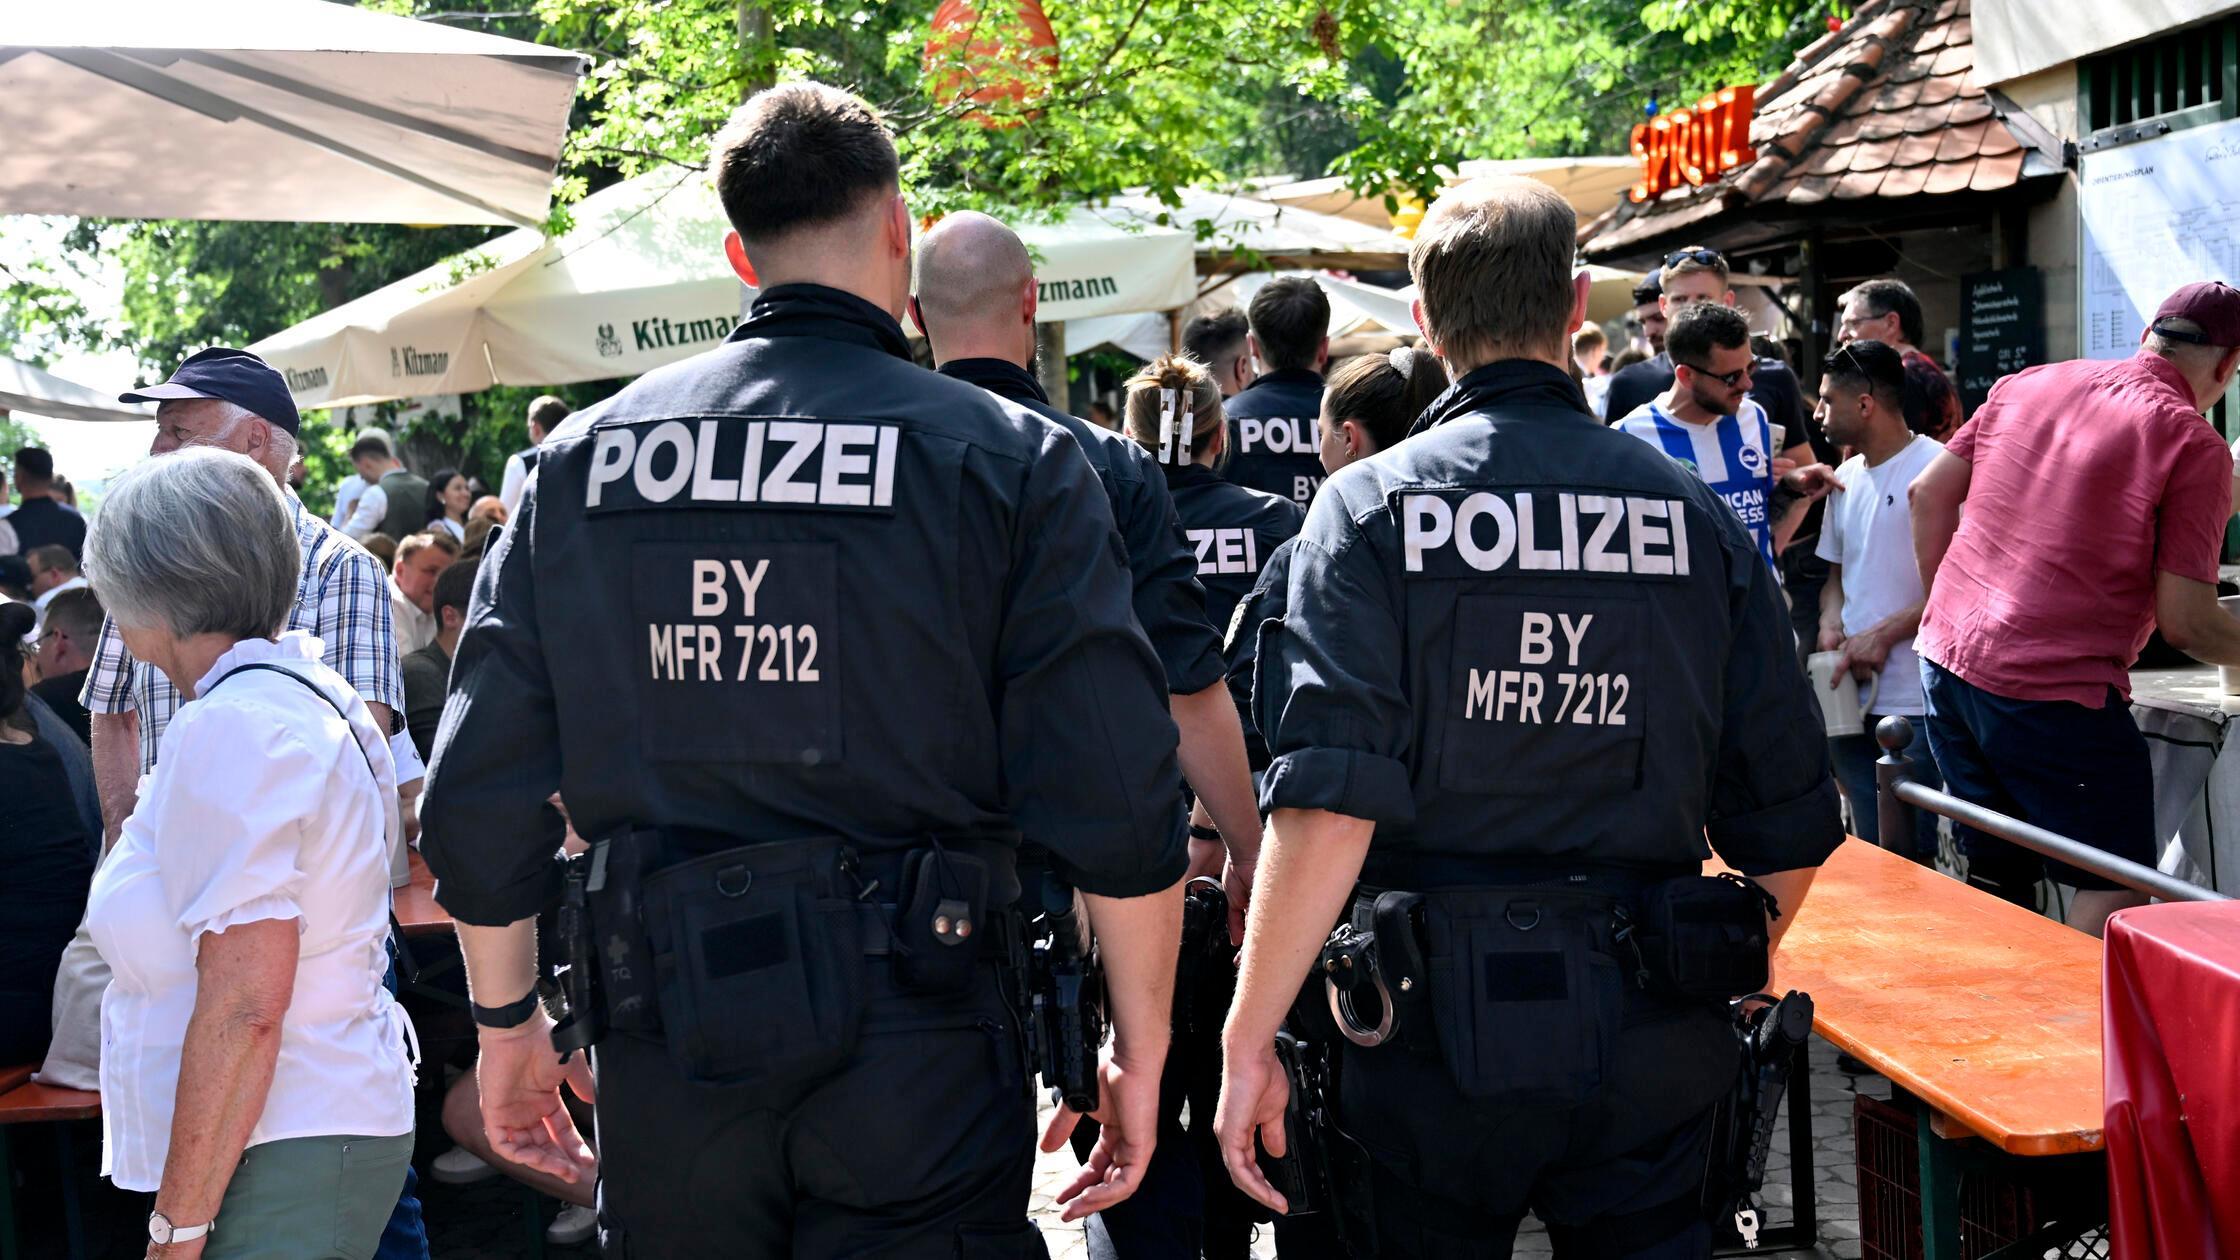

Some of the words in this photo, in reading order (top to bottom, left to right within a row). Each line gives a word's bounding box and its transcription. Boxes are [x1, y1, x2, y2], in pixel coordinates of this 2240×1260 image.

[1630, 85, 1738, 203] SPRITZ
[284, 366, 329, 393] Kitzmann
[402, 345, 449, 376] Kitzmann
[1240, 417, 1320, 454] POLI
[585, 420, 899, 508] POLIZEI
[1719, 489, 1763, 508] ICAN
[1186, 528, 1256, 574] ZEI
[1403, 492, 1690, 576] POLIZEI
[692, 559, 770, 617] BY
[650, 623, 722, 682] MFR
[734, 624, 820, 682] 7212
[1520, 611, 1593, 666] BY
[1465, 668, 1542, 724] MFR
[1554, 673, 1629, 725] 7212
